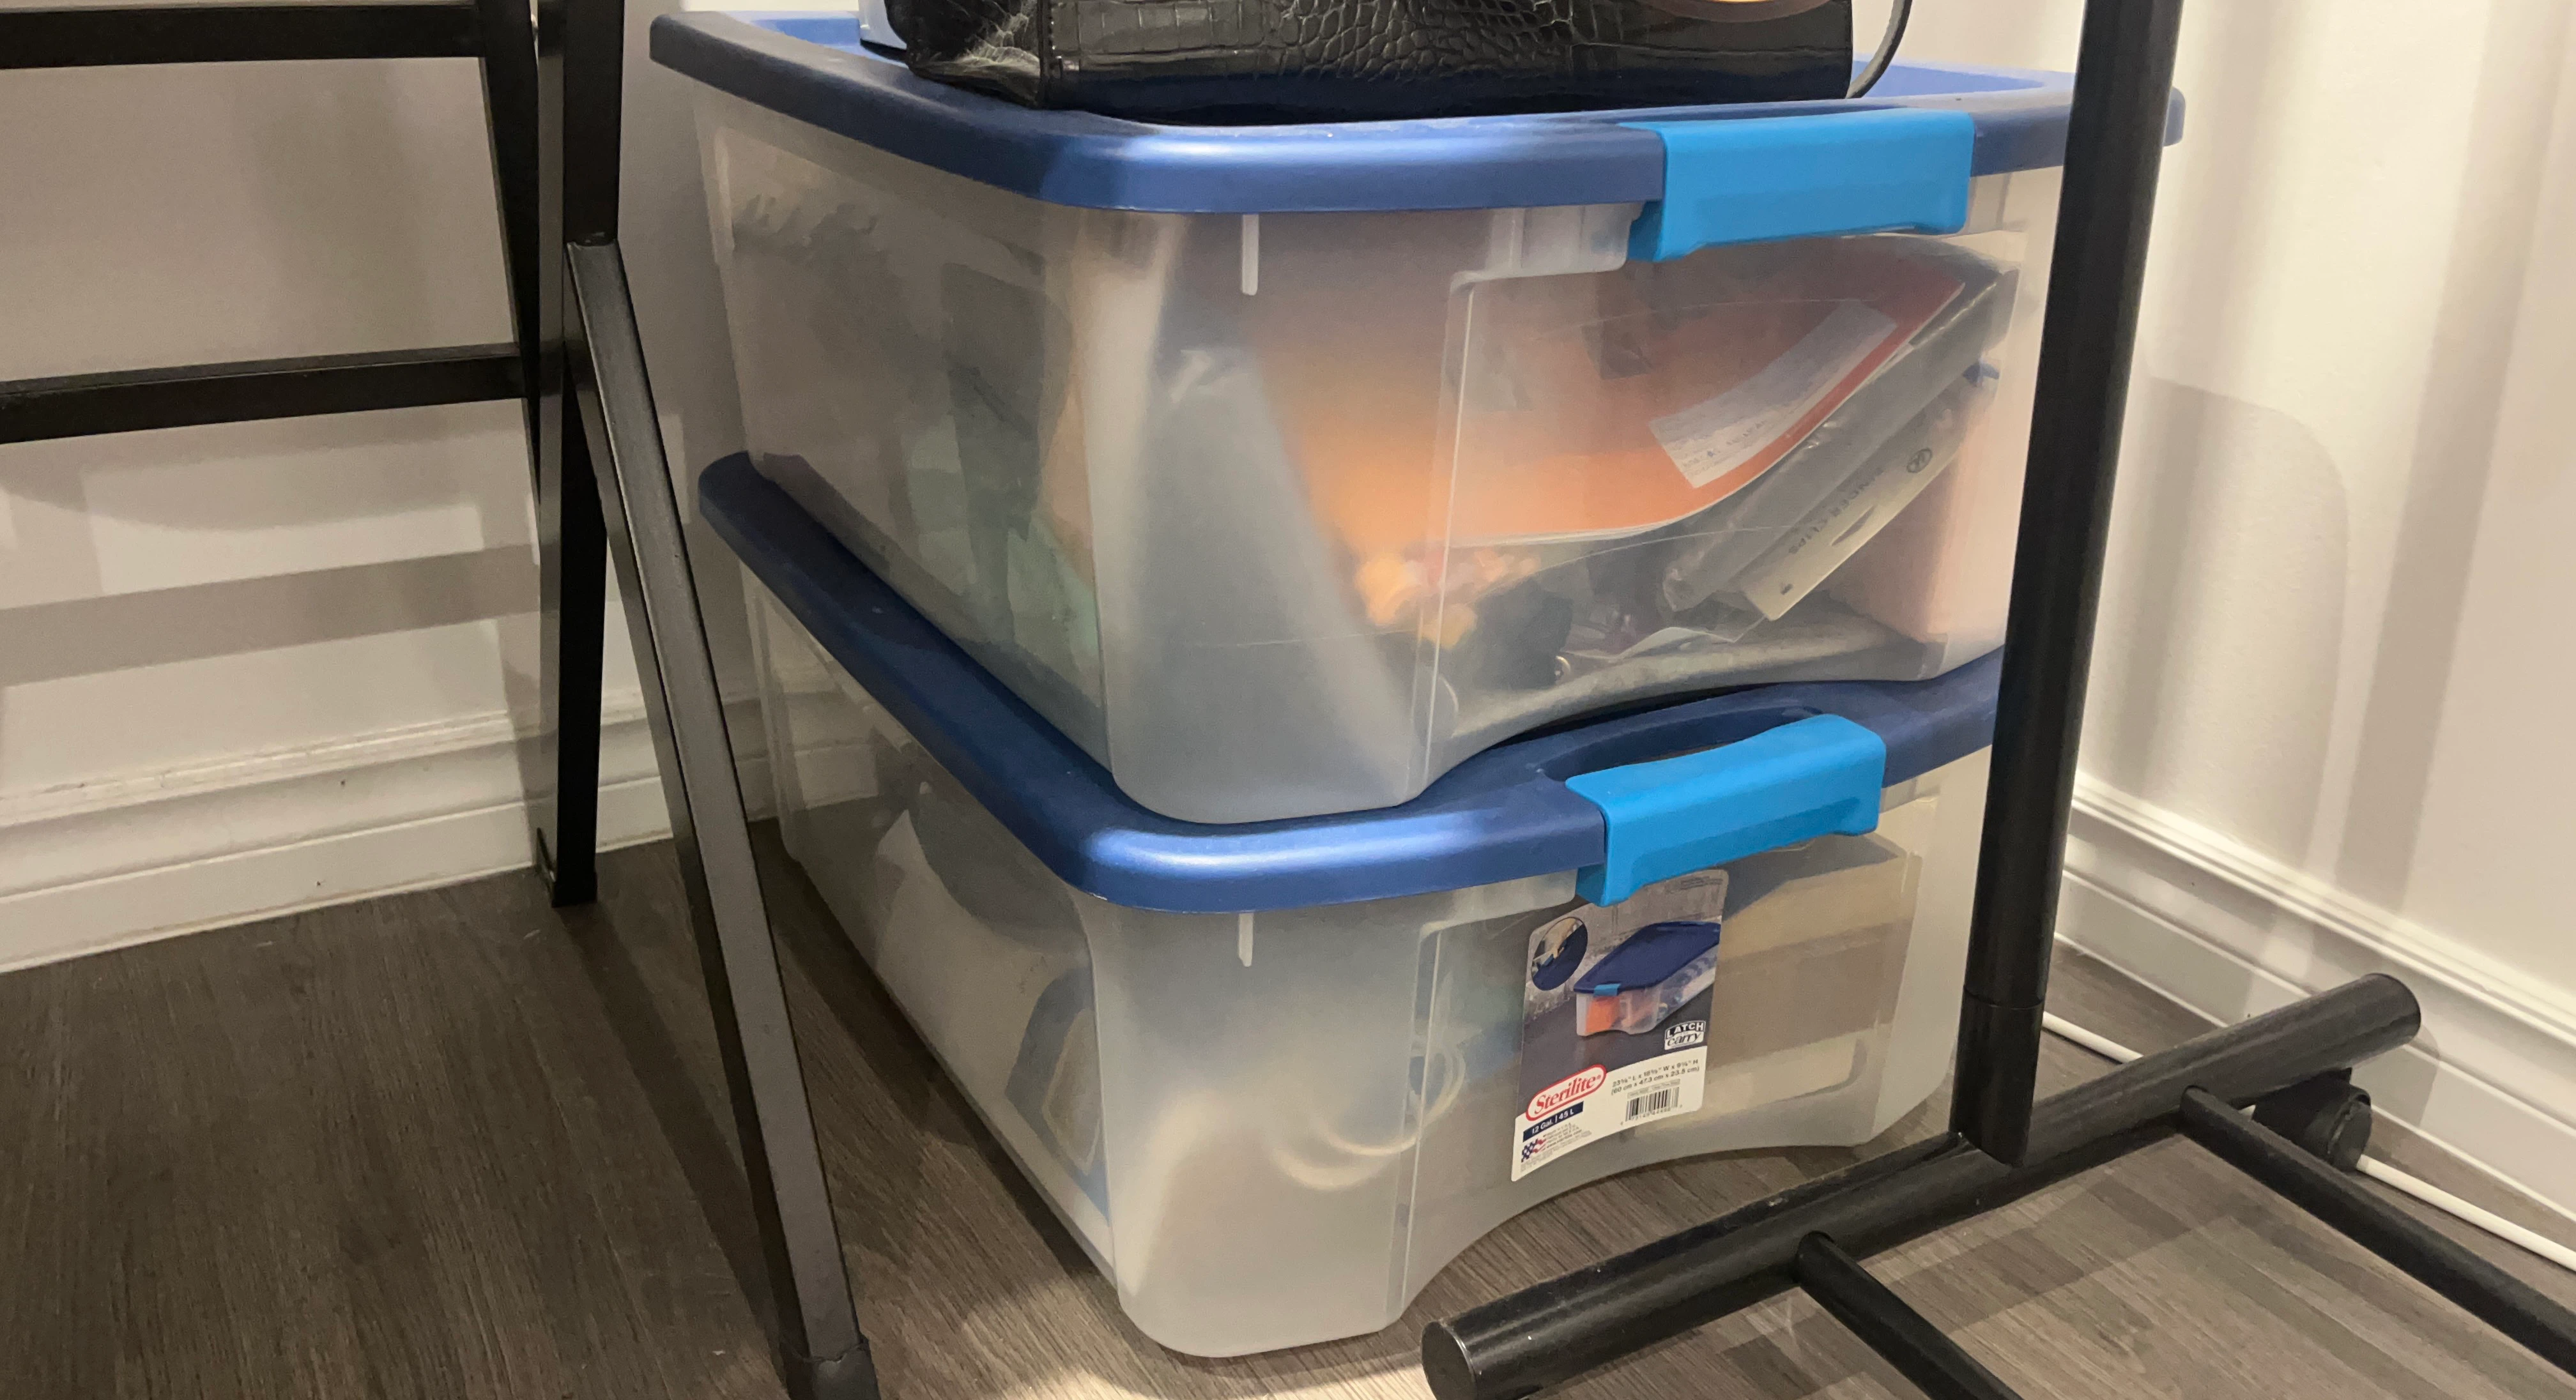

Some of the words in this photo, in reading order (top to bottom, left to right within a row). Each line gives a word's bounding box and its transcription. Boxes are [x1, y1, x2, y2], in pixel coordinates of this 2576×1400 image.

[1667, 1023, 1704, 1039] LATCH
[1667, 1032, 1702, 1046] carry
[1535, 1076, 1596, 1114] Sterilite
[1531, 1126, 1539, 1134] 12
